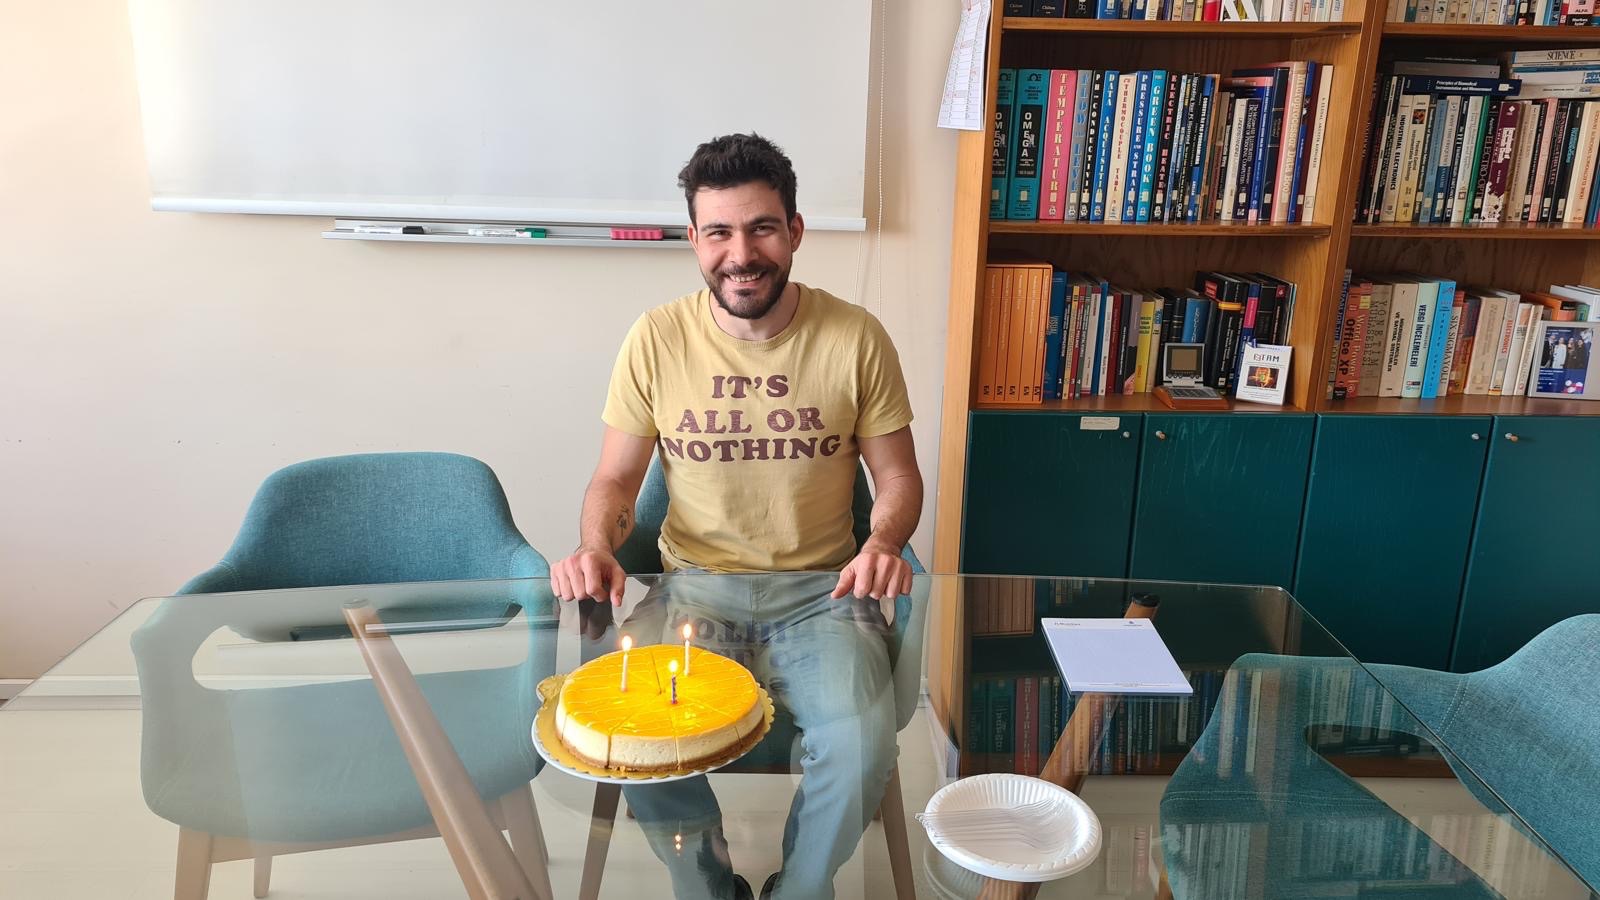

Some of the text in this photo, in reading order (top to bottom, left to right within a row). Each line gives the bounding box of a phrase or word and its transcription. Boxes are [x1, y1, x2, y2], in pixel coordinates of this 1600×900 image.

[1547, 50, 1576, 60] SCIENCE
[1135, 75, 1148, 142] PRESSURE
[1164, 75, 1178, 139] ELECTRIC
[1021, 112, 1032, 157] OMEGA
[1050, 73, 1068, 191] TEMPERATUR
[1098, 74, 1115, 189] DATA ACQUISITI
[1142, 86, 1160, 183] GREEN BOOK
[1282, 73, 1305, 192] Microprocessor Data Boo
[1390, 114, 1406, 191] INDUSTRIAL ELECTRONICS
[1071, 143, 1081, 192] LEVE
[1477, 136, 1493, 199] ELECTRO-OPTI
[1342, 318, 1355, 355] Office
[1417, 304, 1427, 323] VERGİ
[1449, 315, 1458, 330] SIX
[1502, 319, 1513, 354] ELECTRONICS
[1339, 360, 1350, 376] XP
[1348, 314, 1366, 377] Word Power
[1409, 323, 1422, 367] İNCELEMELERİ
[675, 407, 826, 434] ALL OR
[663, 434, 842, 463] NOTHING
